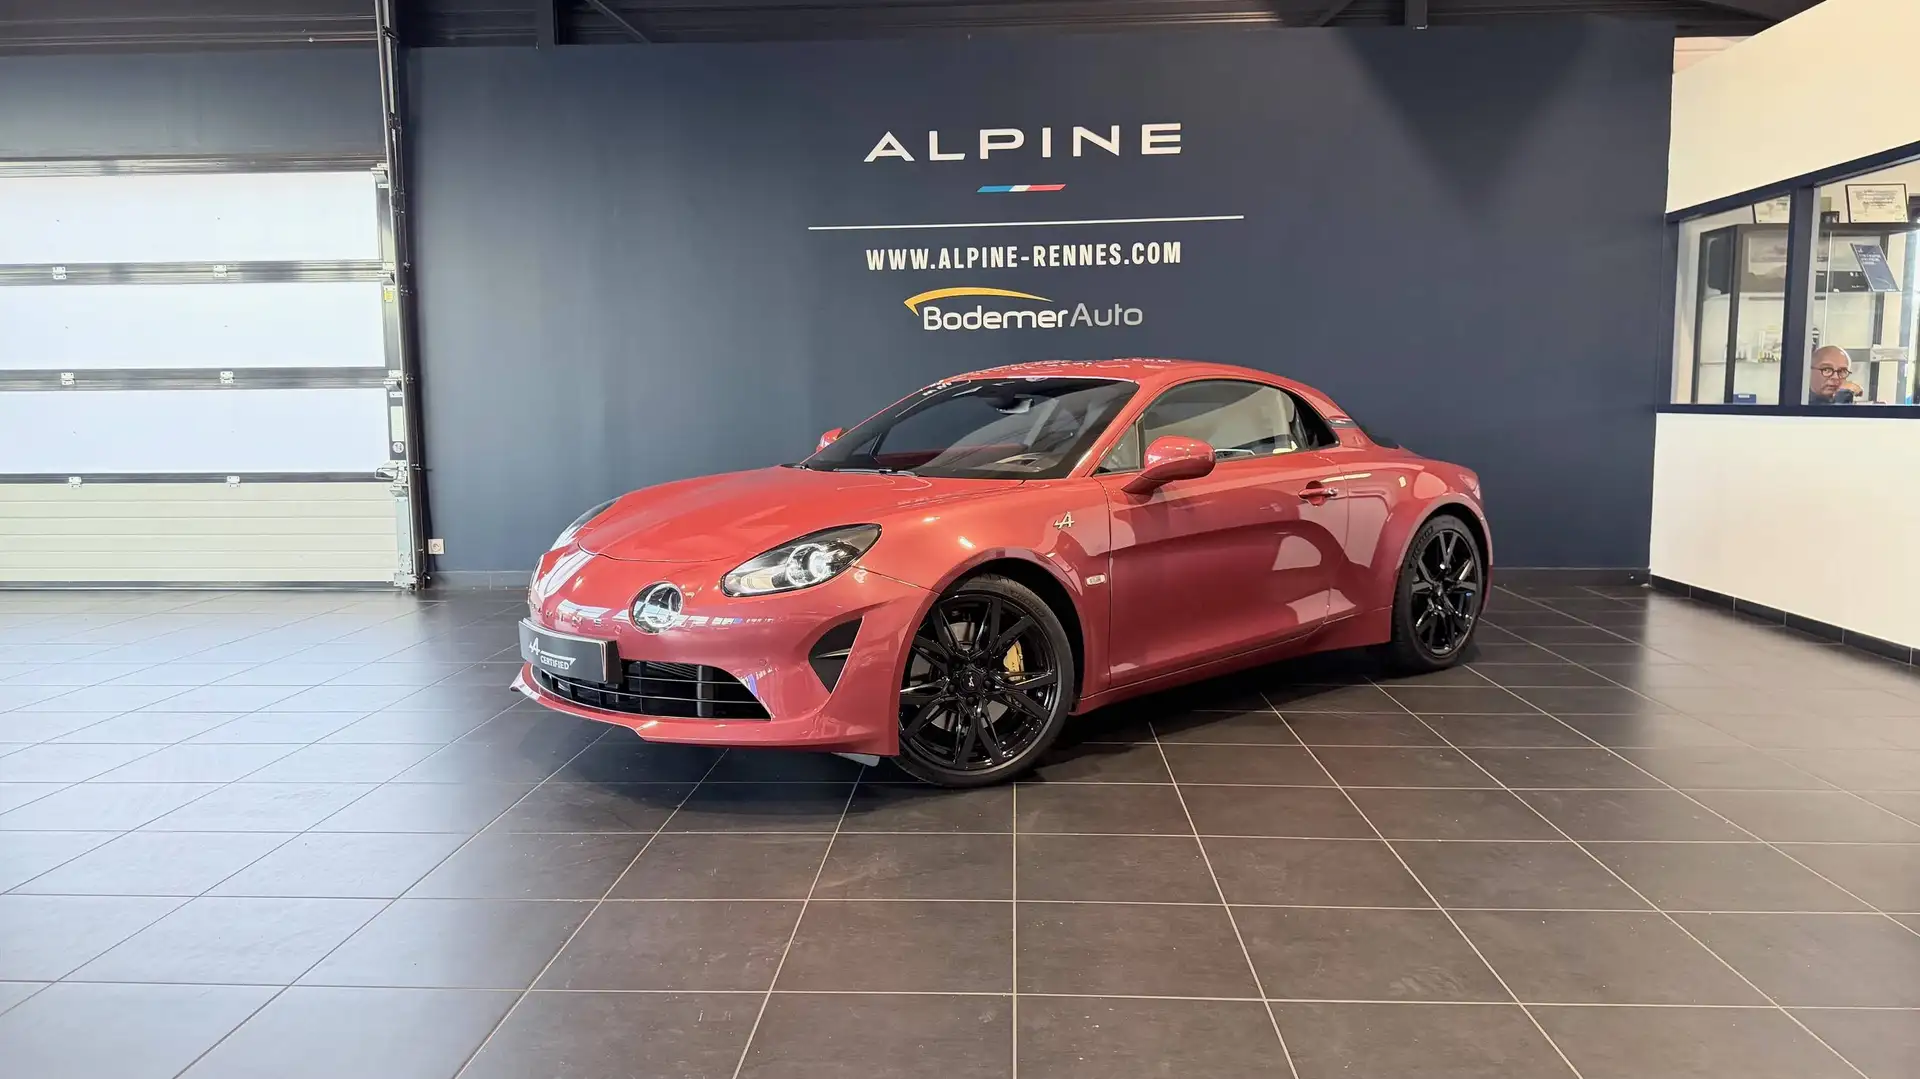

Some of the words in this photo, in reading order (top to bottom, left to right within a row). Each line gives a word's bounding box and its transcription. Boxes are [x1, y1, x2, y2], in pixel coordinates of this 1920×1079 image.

[864, 123, 1181, 162] ALPINE
[866, 242, 1180, 270] WWW.ALPINE-RENNES.COM
[540, 655, 570, 670] CERTIFIED
